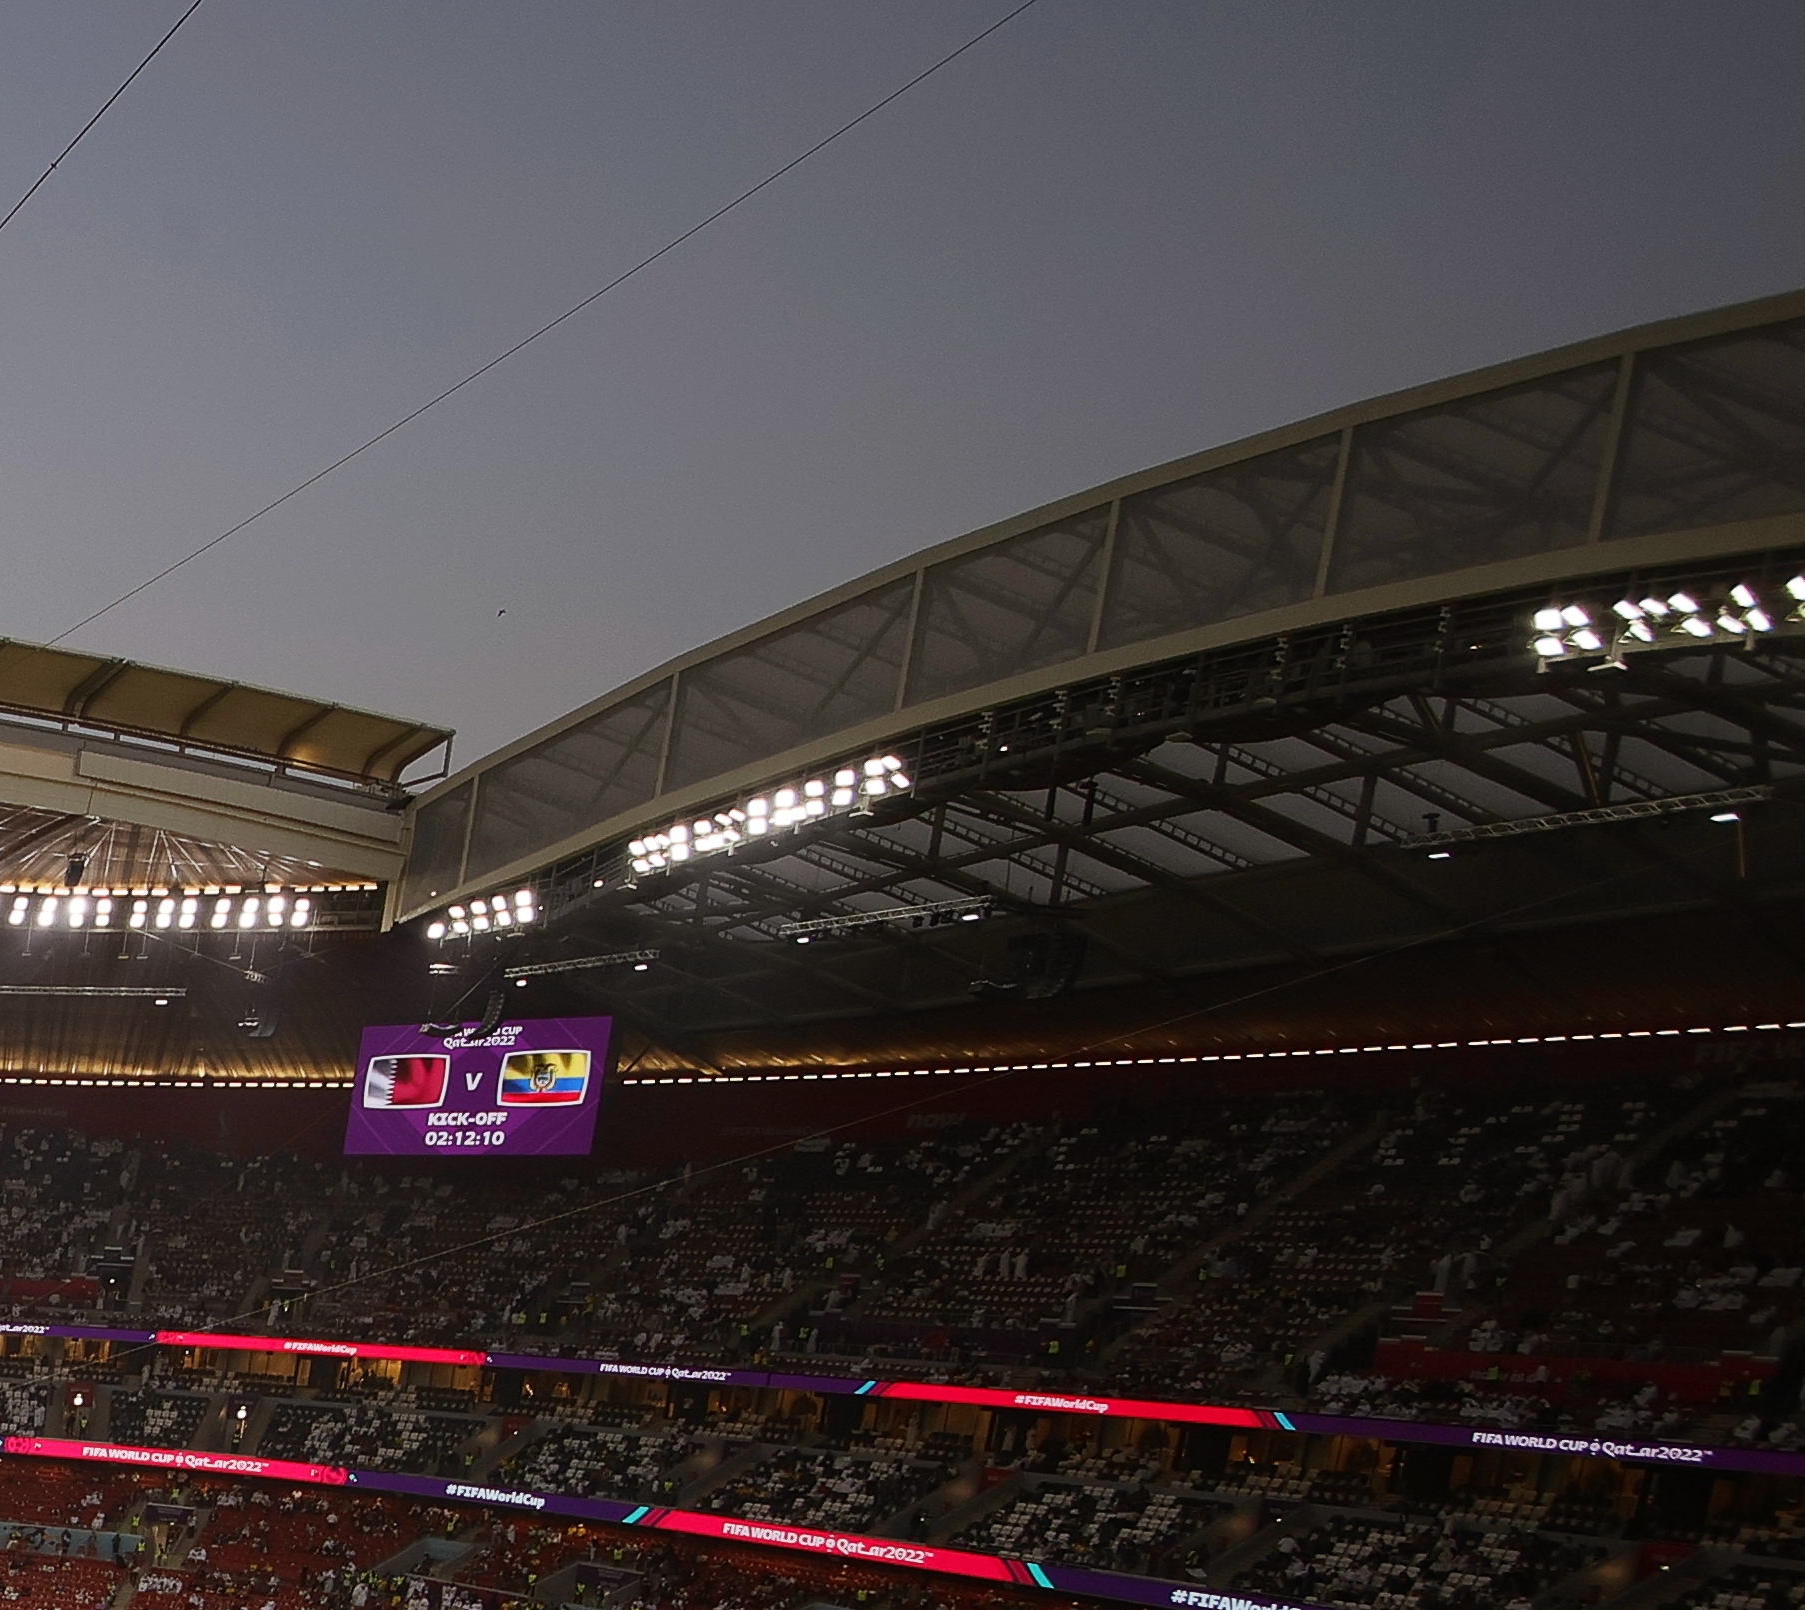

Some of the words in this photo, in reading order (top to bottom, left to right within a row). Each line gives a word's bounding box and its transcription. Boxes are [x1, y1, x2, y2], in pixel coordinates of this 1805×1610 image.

[427, 1112, 508, 1126] KICK-OFF
[424, 1131, 505, 1146] 02:12:10
[284, 1342, 357, 1356] #FIFAWorldCup
[599, 1363, 618, 1373] FIFA
[618, 1364, 648, 1375] WORLD
[648, 1367, 665, 1377] CUP
[1014, 1395, 1108, 1413] #FIFAWorldCup
[1472, 1432, 1504, 1446] FIFA
[1505, 1434, 1557, 1450] WORLD
[1559, 1438, 1589, 1452] CUP
[82, 1447, 109, 1458] FIFA
[109, 1447, 151, 1461] WORLD
[151, 1450, 175, 1463] CUP
[446, 1483, 545, 1509] #FIFAWorldCup
[723, 1523, 750, 1538] FIFA
[750, 1526, 798, 1544] WORLD
[798, 1534, 824, 1548] CUP
